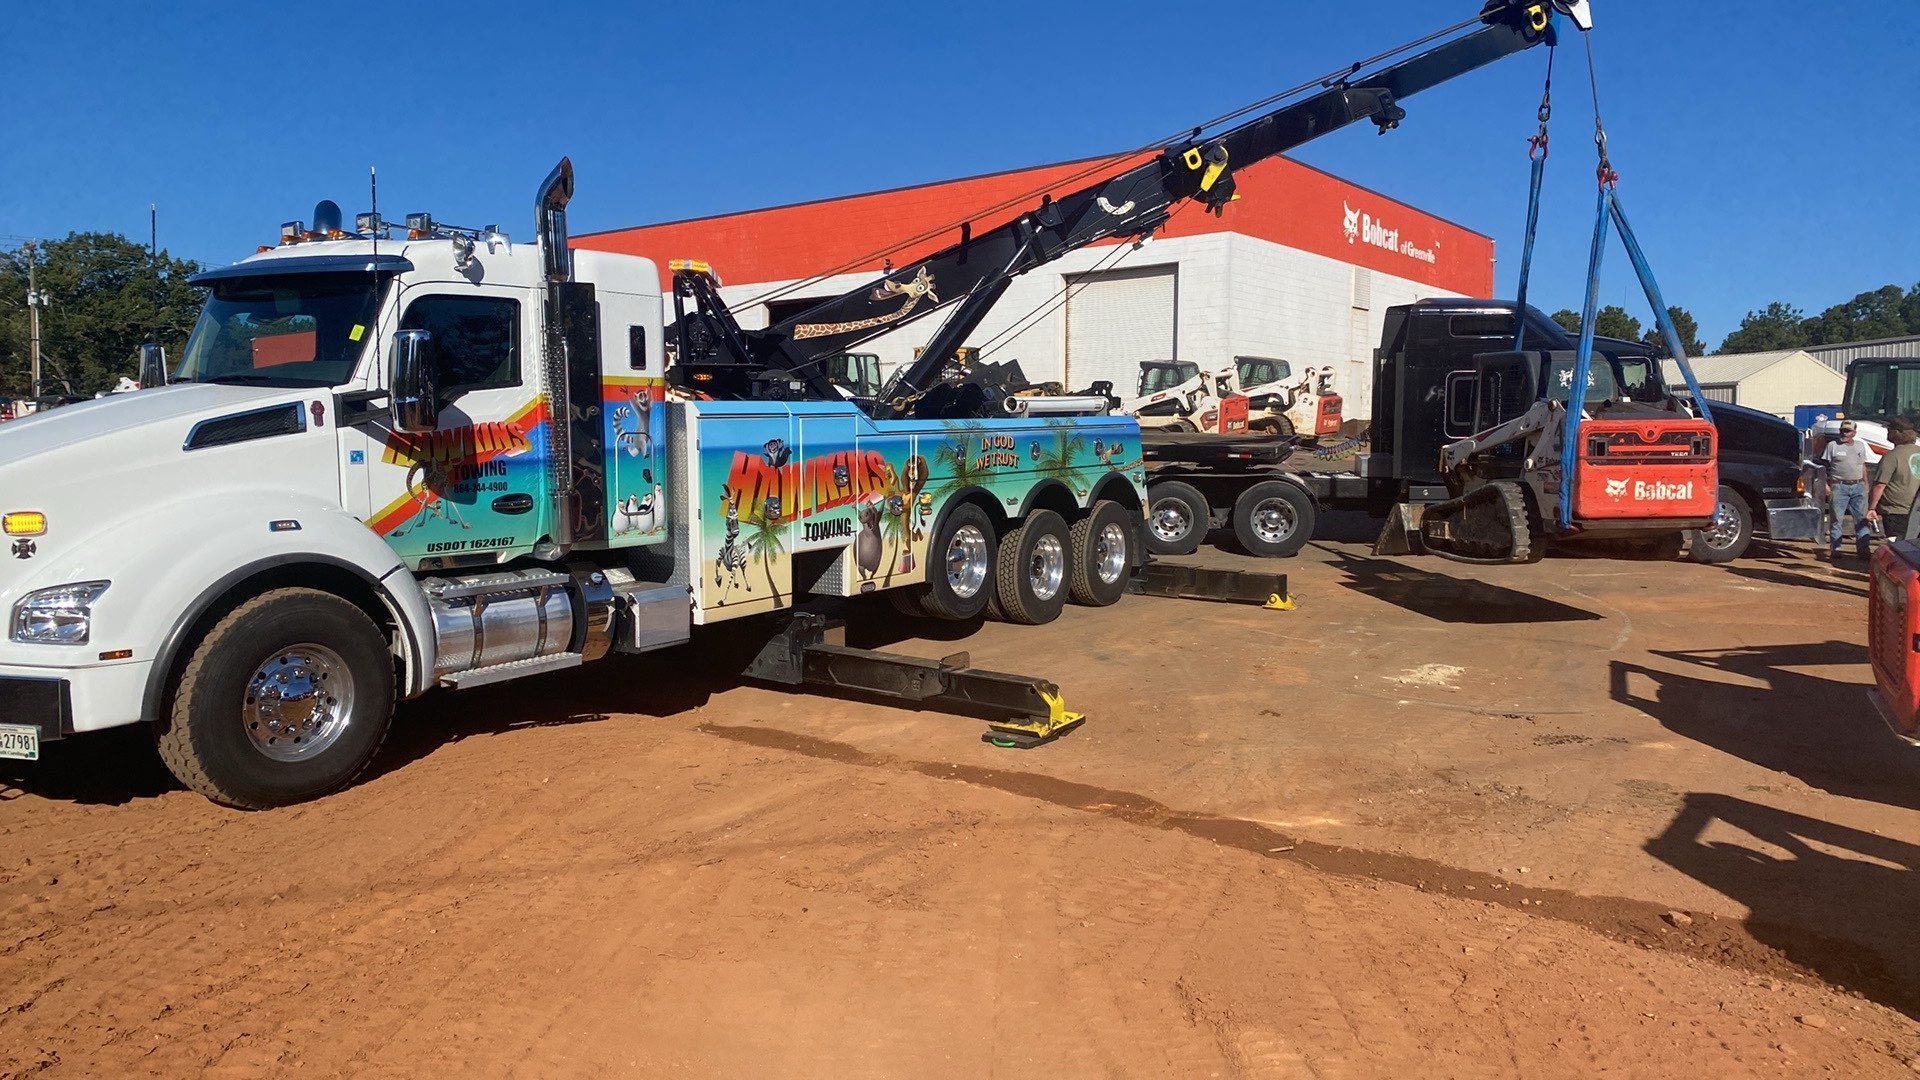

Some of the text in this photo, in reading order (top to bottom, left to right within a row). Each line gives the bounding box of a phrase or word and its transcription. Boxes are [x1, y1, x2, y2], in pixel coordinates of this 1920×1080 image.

[1362, 213, 1435, 264] Bobcat of Greenville
[381, 421, 533, 469] HAWKINS
[981, 435, 1016, 453] IN GOD
[453, 460, 507, 480] TOWING
[976, 452, 1019, 471] WE TRUST
[719, 449, 887, 524] HAWKINS
[1634, 480, 1694, 501] Bobcat
[804, 517, 852, 542] TOWING
[427, 536, 515, 553] USDOT 1624167
[4, 734, 36, 750] 27981
